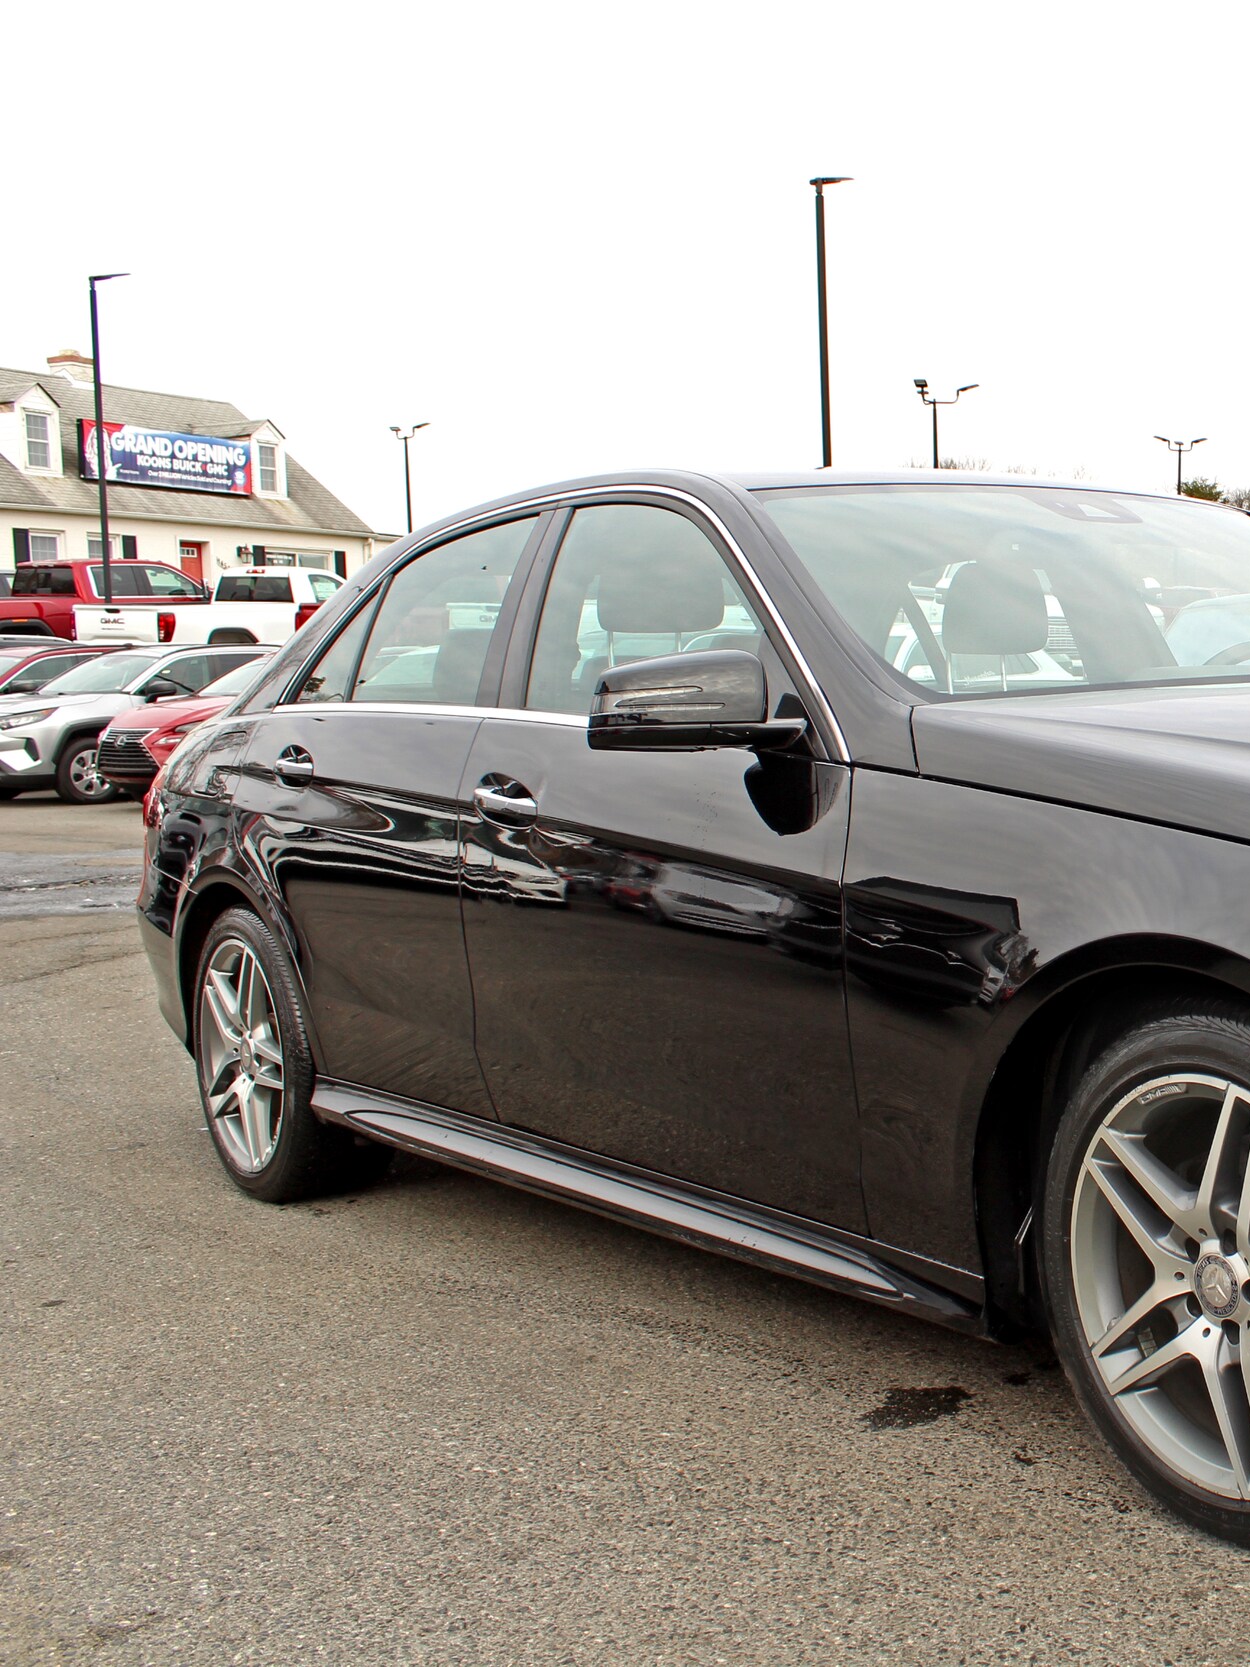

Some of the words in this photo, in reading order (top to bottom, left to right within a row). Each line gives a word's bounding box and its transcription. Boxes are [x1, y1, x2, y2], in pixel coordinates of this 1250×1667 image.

[111, 431, 173, 457] GRAND
[173, 441, 246, 467] OPENING
[136, 455, 172, 469] KOONS
[173, 460, 203, 474] BUICK
[207, 464, 228, 476] GMC
